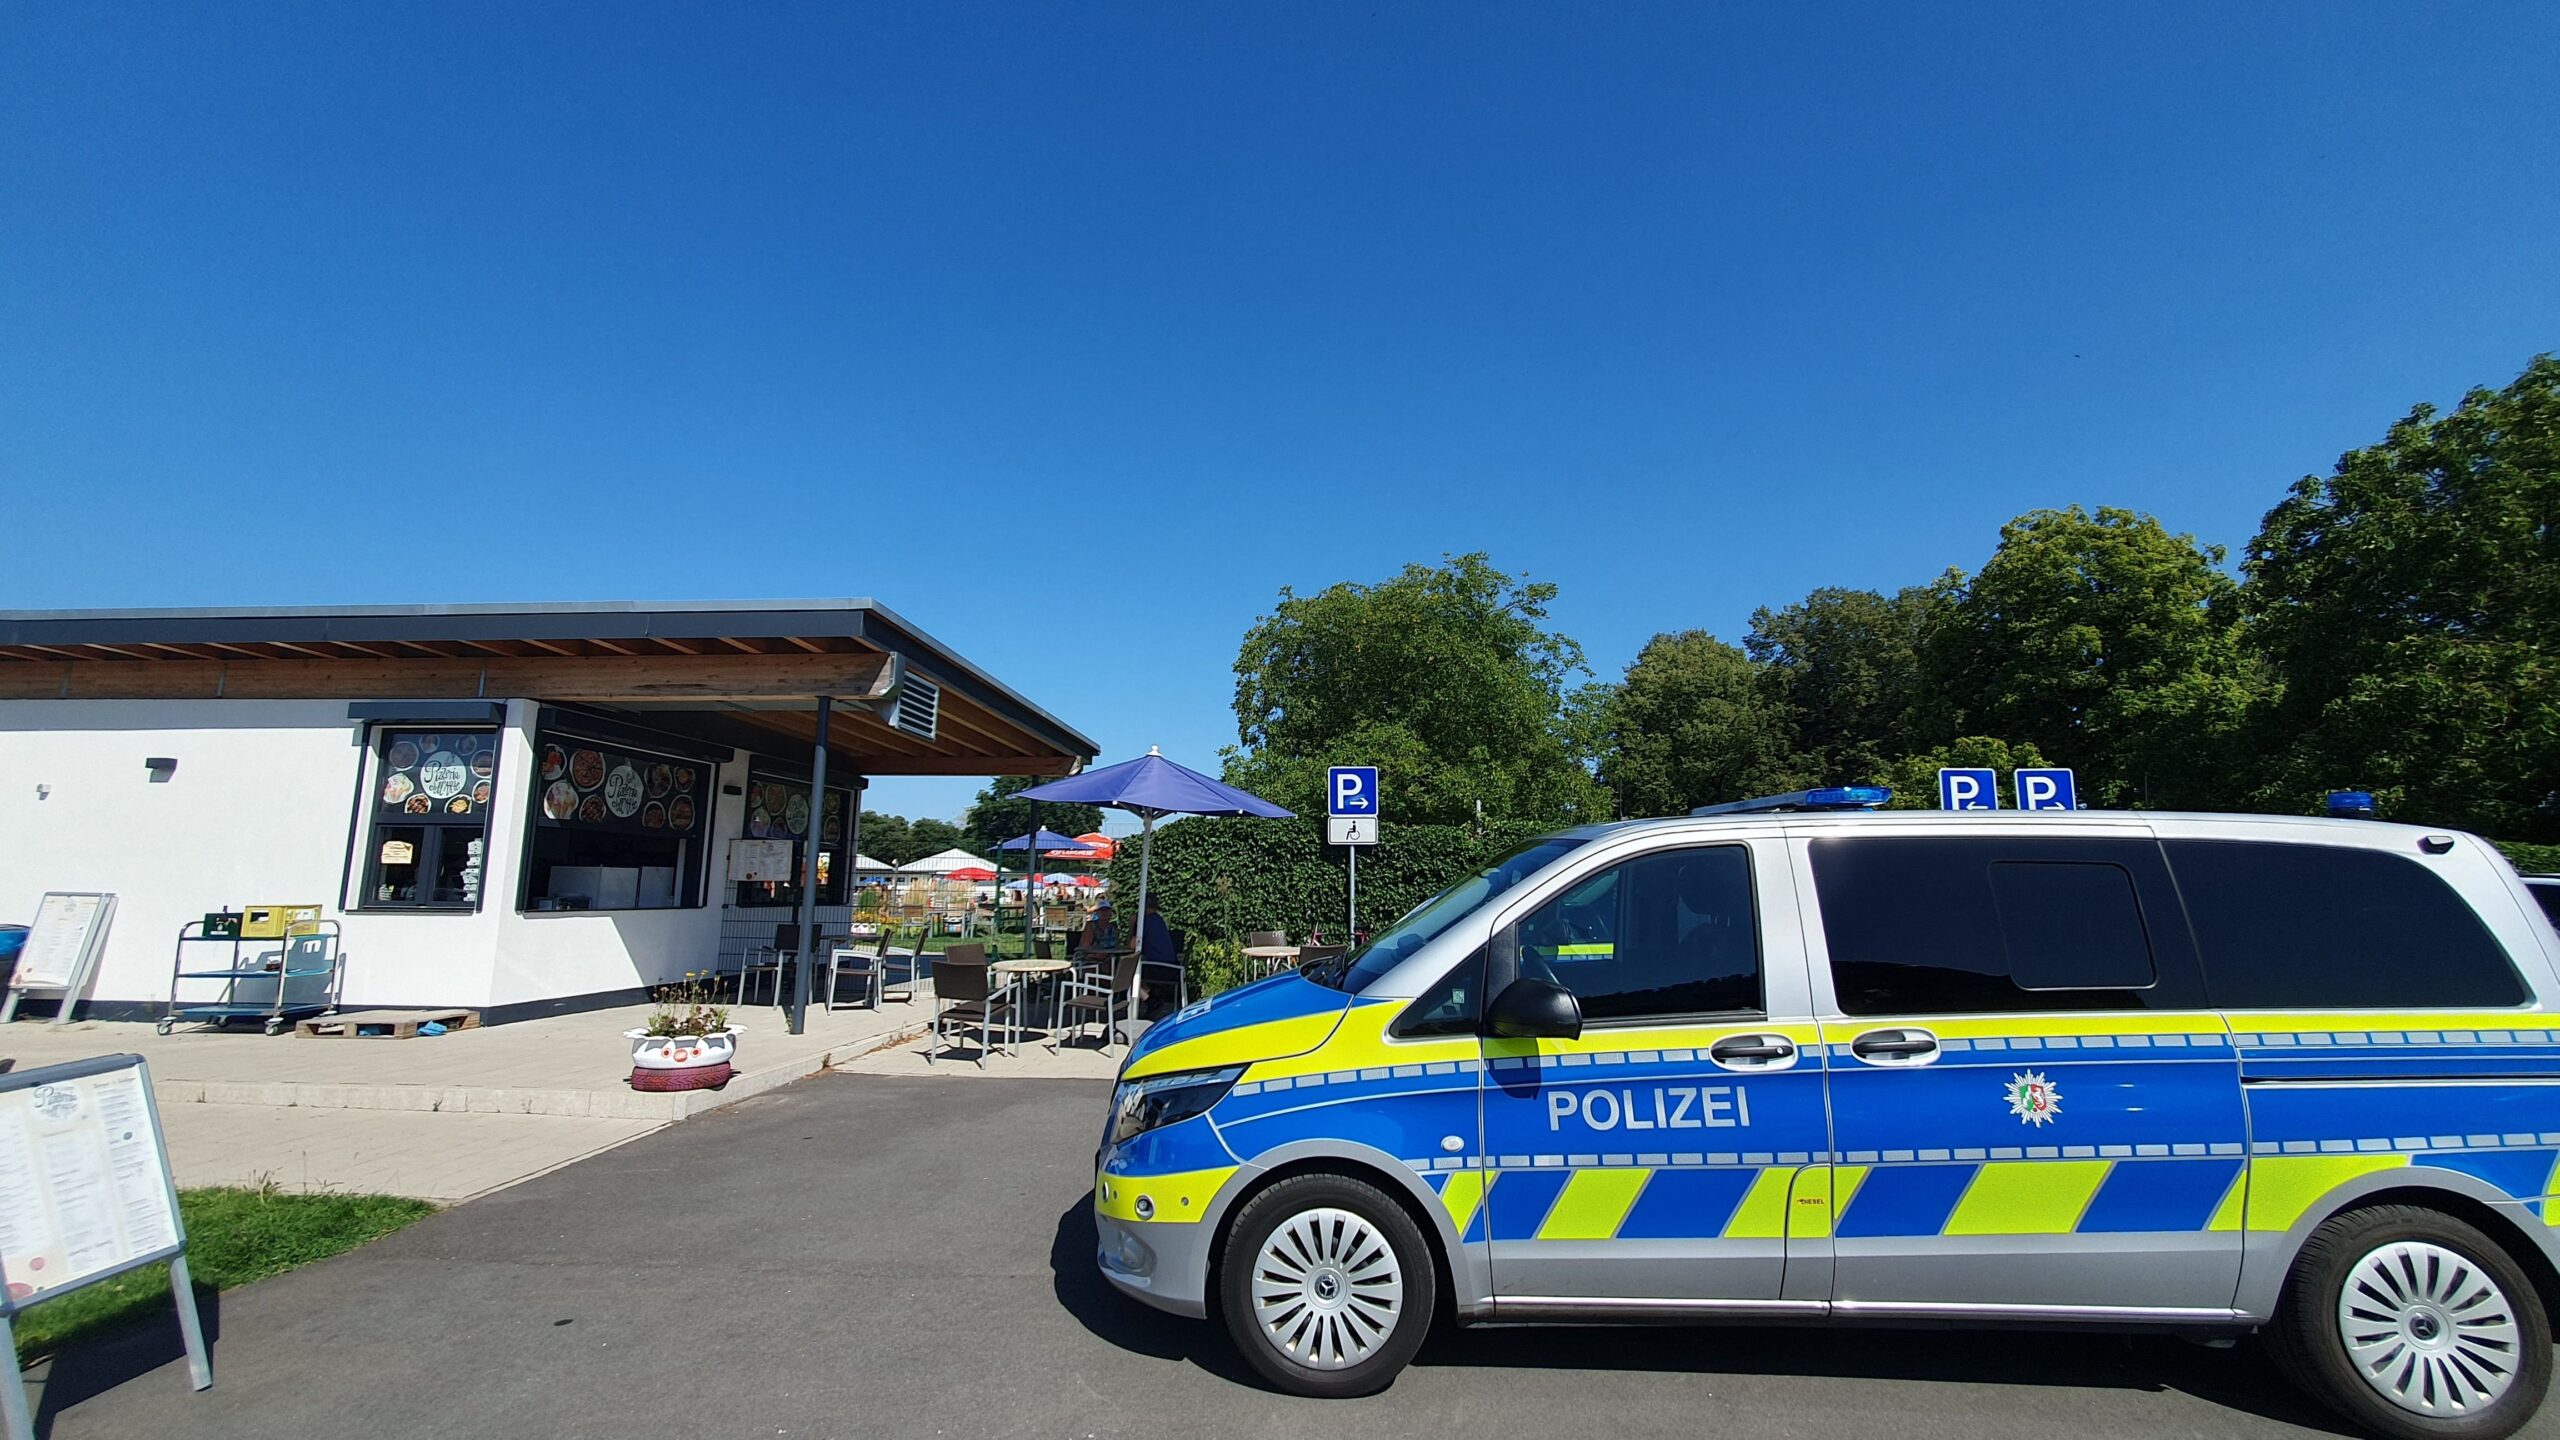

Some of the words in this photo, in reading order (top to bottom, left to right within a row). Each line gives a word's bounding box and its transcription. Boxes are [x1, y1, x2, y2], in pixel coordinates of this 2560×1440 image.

[1337, 773, 1363, 810] P
[1949, 775, 1980, 811] P
[2025, 776, 2057, 811] P
[1548, 1086, 1750, 1131] POLIZEI
